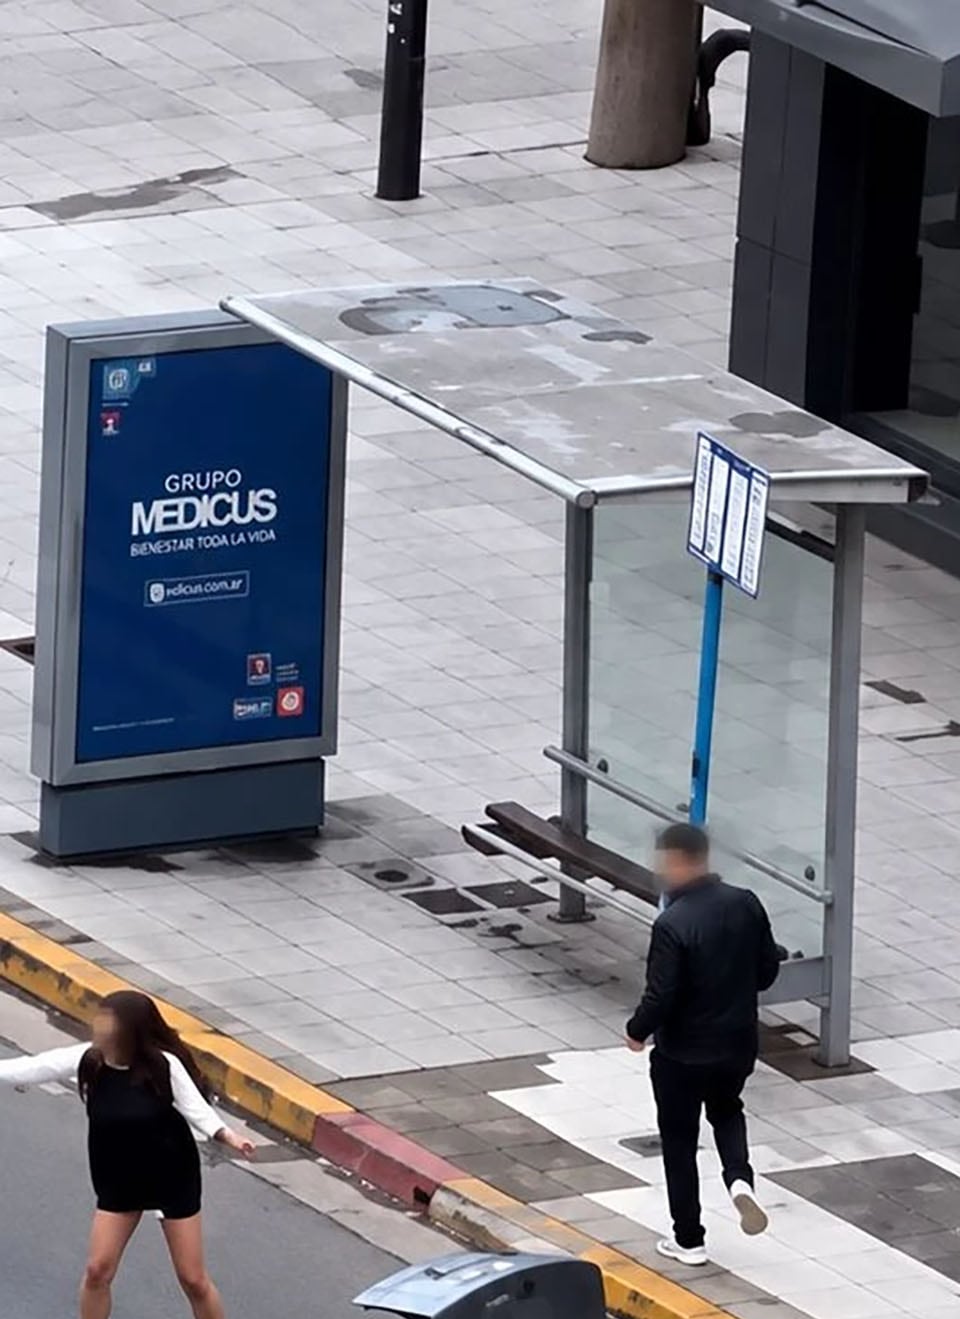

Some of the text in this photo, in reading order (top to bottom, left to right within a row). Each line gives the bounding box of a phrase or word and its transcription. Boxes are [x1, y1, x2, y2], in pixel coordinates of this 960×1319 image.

[164, 468, 242, 493] GRUPO
[131, 488, 278, 536] MEDICUS
[130, 529, 276, 557] BIENESTAR TODA LA VIDA
